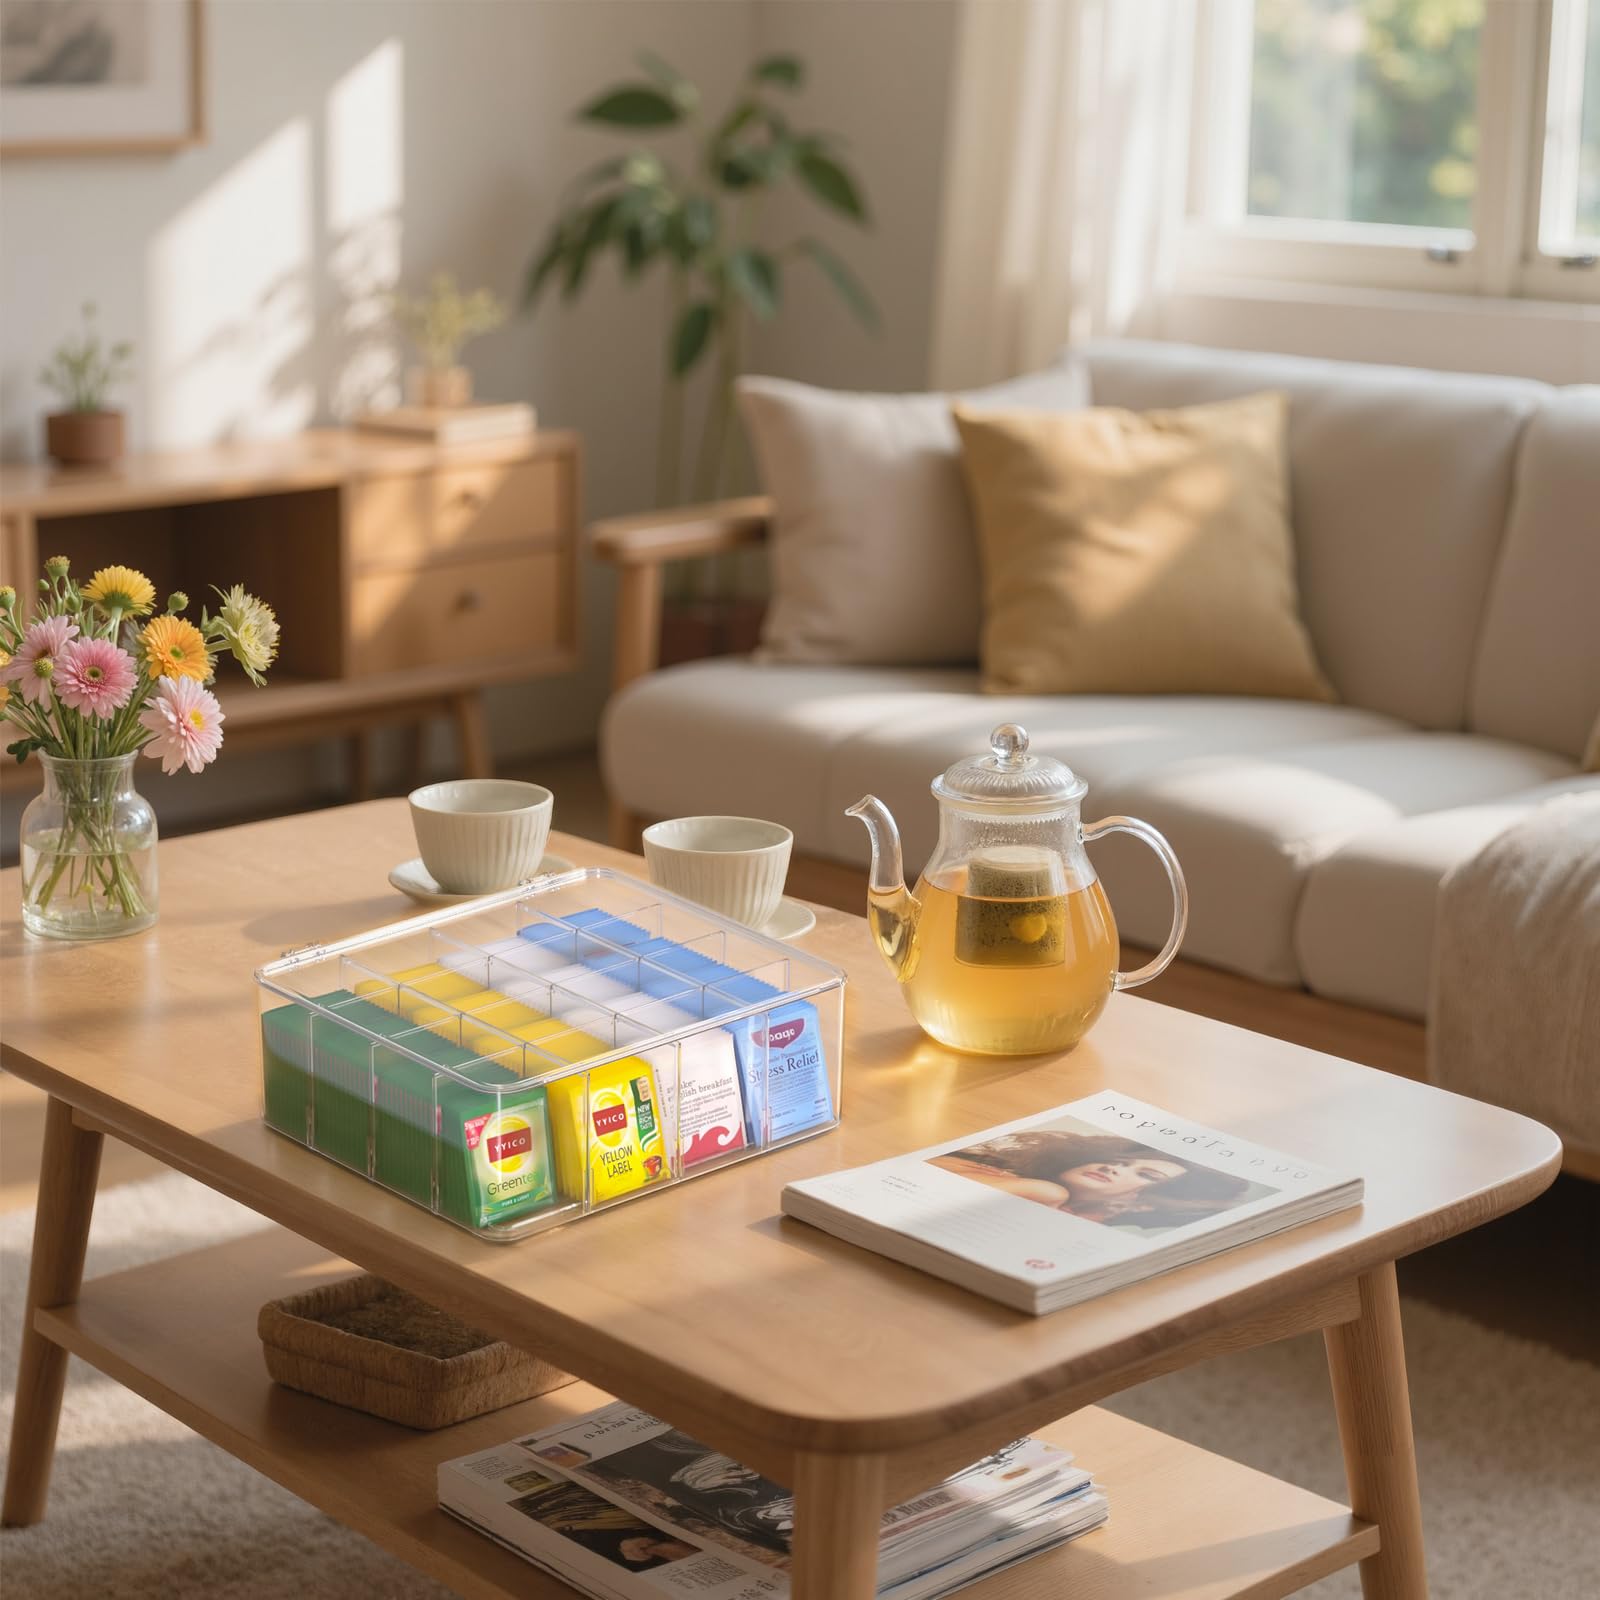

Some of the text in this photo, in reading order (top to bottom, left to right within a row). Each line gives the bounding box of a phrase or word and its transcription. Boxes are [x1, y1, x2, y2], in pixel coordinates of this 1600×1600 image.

[698, 1077, 733, 1093] breakfast
[596, 1113, 625, 1127] YYICO
[494, 1137, 526, 1153] YYICO
[600, 1145, 633, 1166] YELLOW
[607, 1160, 633, 1178] LABEL
